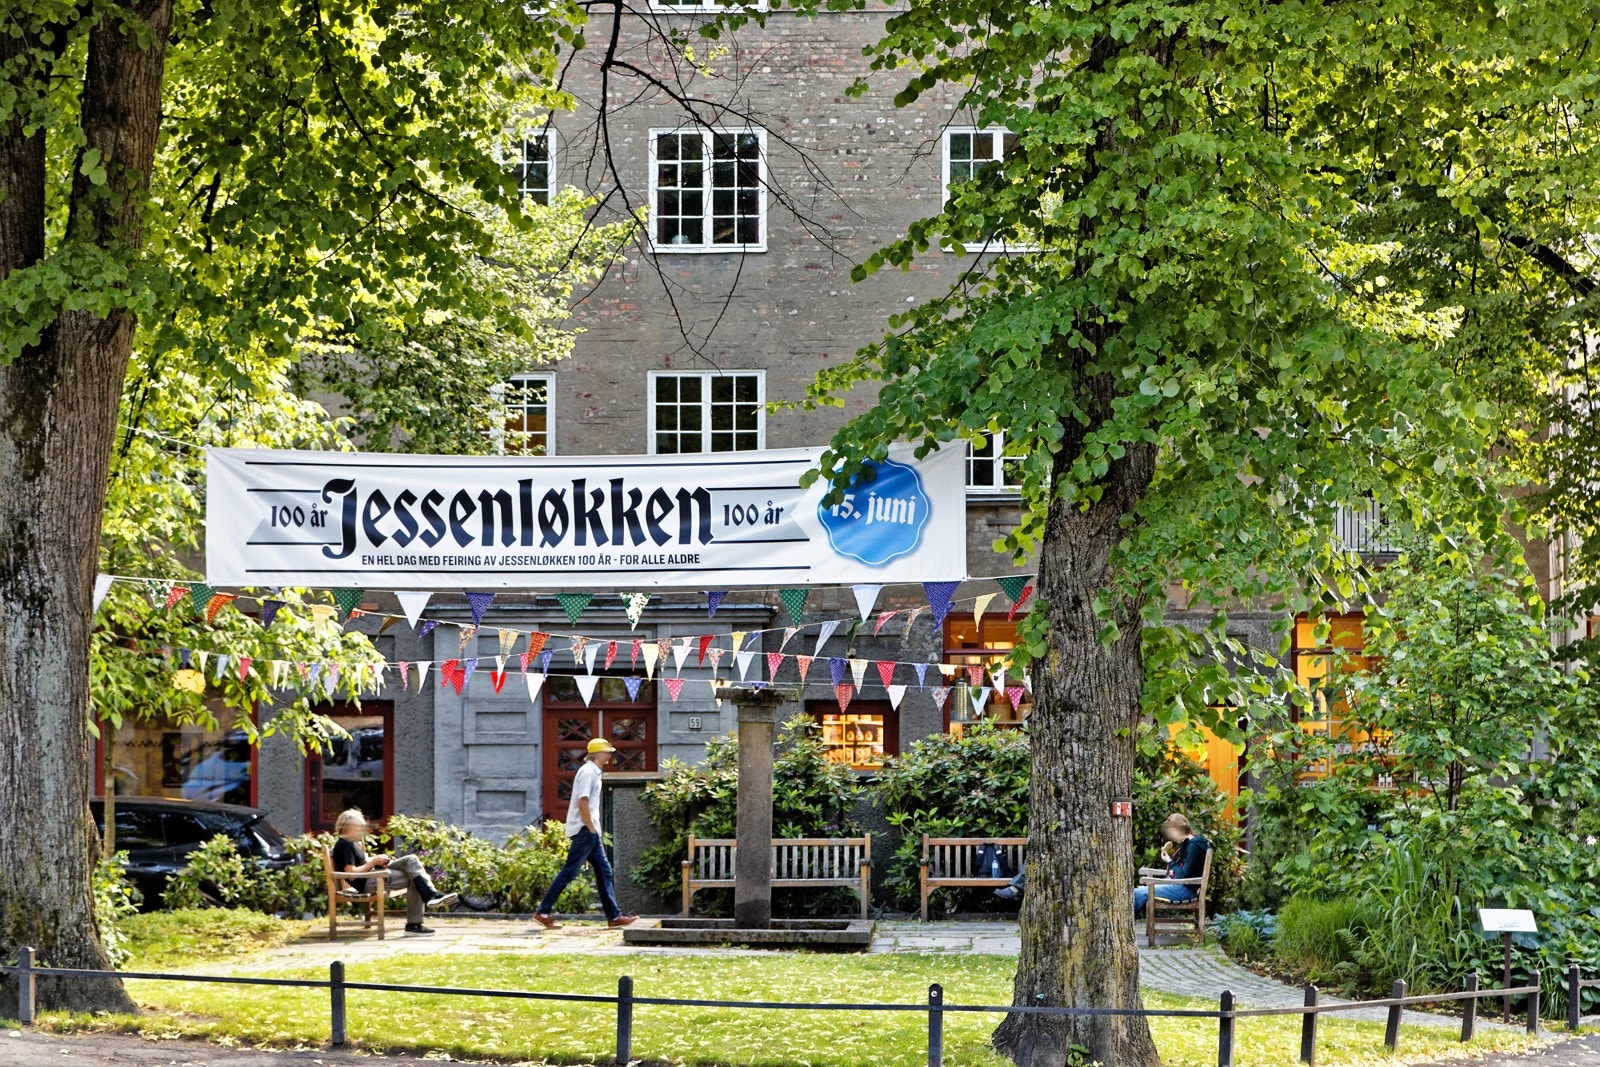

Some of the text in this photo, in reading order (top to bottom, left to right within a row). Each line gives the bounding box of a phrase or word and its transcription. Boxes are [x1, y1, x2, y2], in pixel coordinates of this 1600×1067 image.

[270, 502, 328, 528] 100 år
[321, 477, 714, 560] Jessenløkken
[723, 500, 785, 527] 100 år
[865, 491, 917, 525] juni
[361, 555, 375, 566] EN
[376, 555, 395, 566] HEL
[397, 555, 417, 566] DAG
[418, 555, 441, 566] MED
[442, 555, 481, 566] FEIRING
[483, 555, 497, 566] AV
[498, 555, 576, 566] JESSENLØKKEN
[577, 555, 596, 565] 100
[597, 553, 611, 565] ÅR
[619, 554, 640, 565] FOR
[641, 554, 666, 565] ALLE
[667, 553, 701, 564] ALDRE
[690, 718, 700, 727] 59
